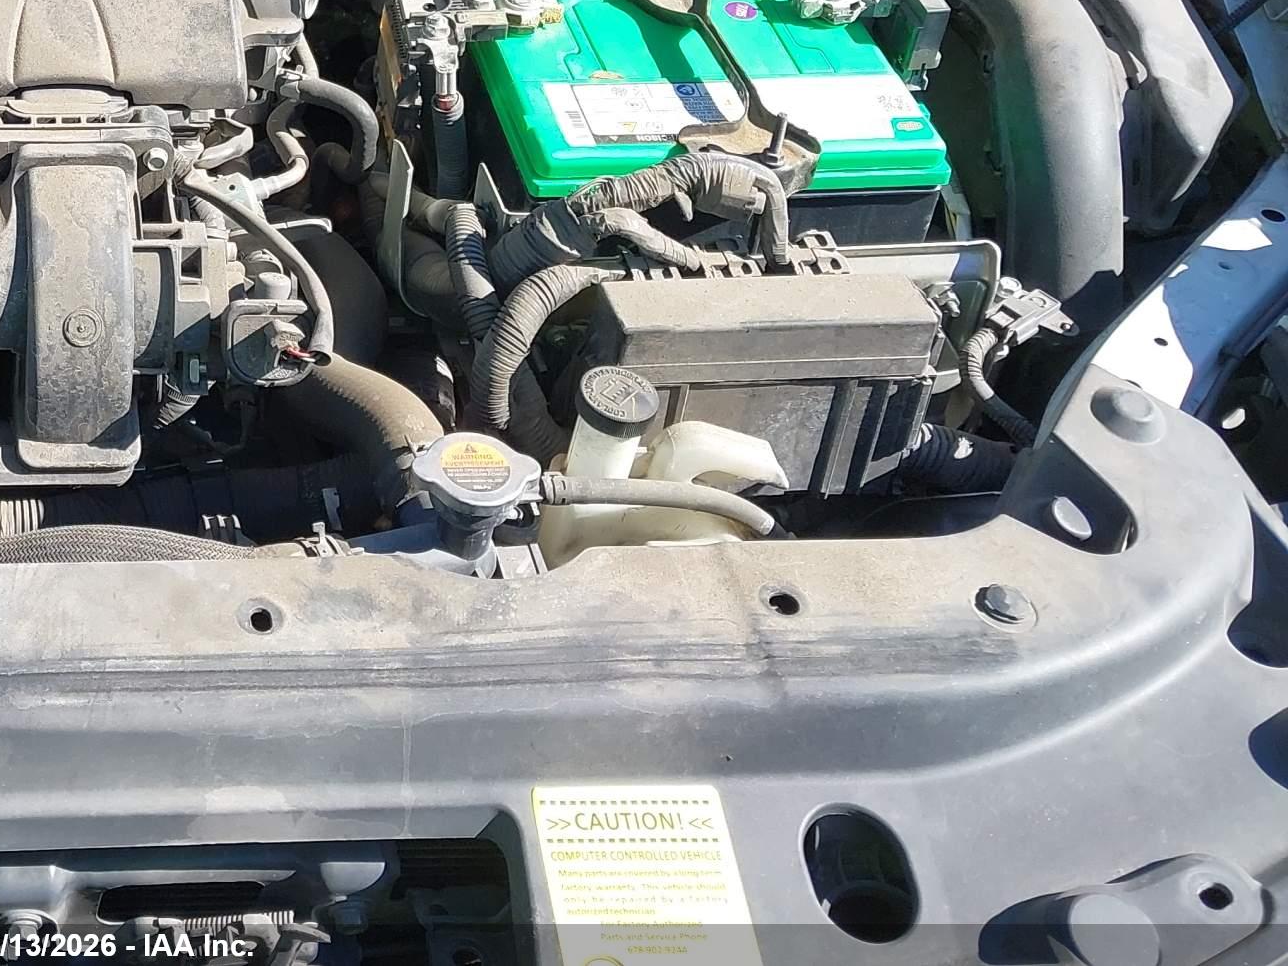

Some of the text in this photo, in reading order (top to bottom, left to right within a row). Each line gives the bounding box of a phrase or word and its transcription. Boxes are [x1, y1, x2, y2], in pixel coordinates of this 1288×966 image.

[550, 850, 721, 862] COMPUTER CONTROLLED VEHICLE
